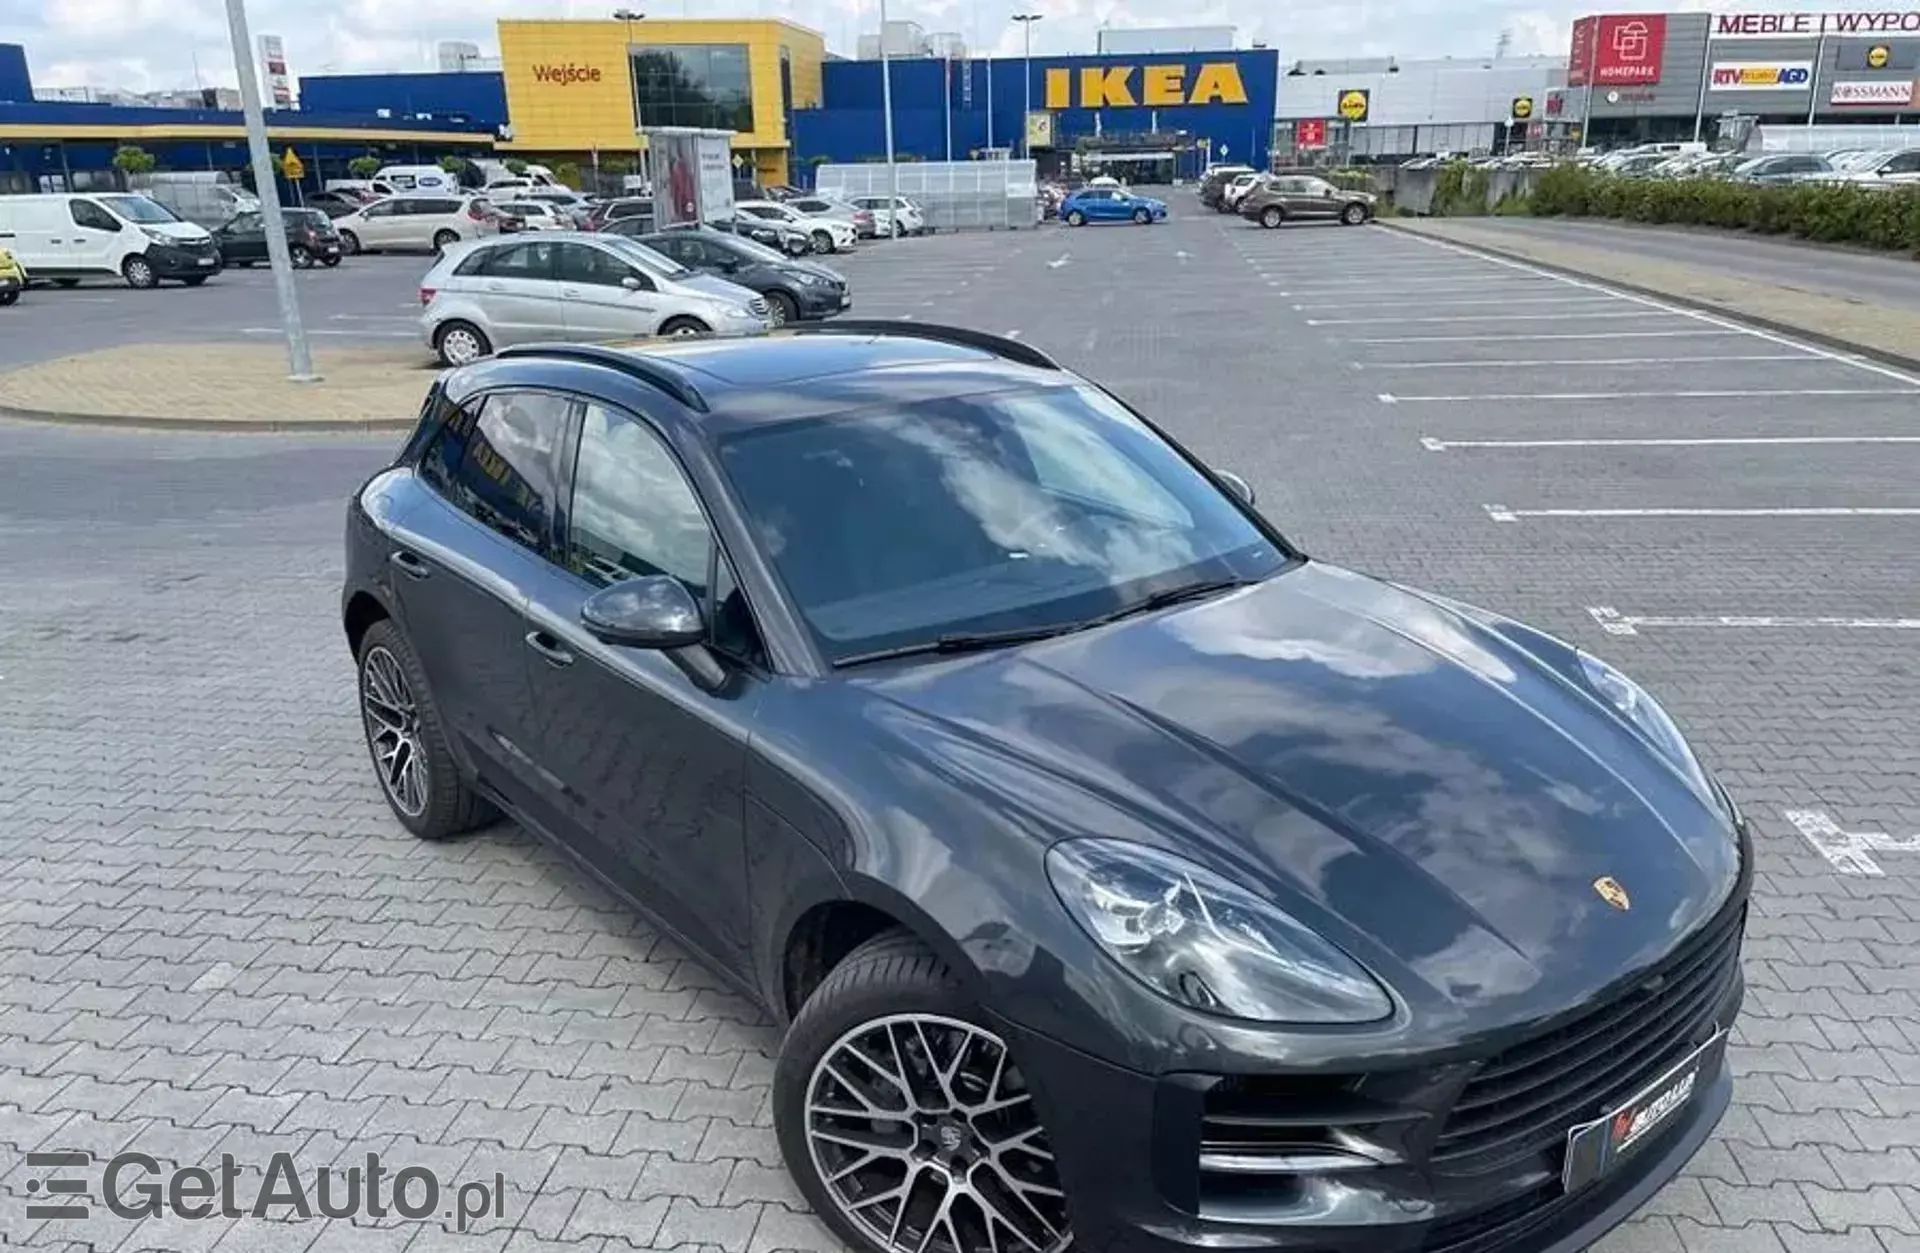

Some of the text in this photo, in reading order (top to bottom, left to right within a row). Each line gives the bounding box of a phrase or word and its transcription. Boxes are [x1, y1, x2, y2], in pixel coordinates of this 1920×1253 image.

[1717, 13, 1810, 34] MEBLE
[531, 62, 602, 87] Wejście
[1599, 65, 1655, 77] HOMEPARK
[1712, 68, 1744, 84] RTV
[1046, 62, 1249, 109] IKEA
